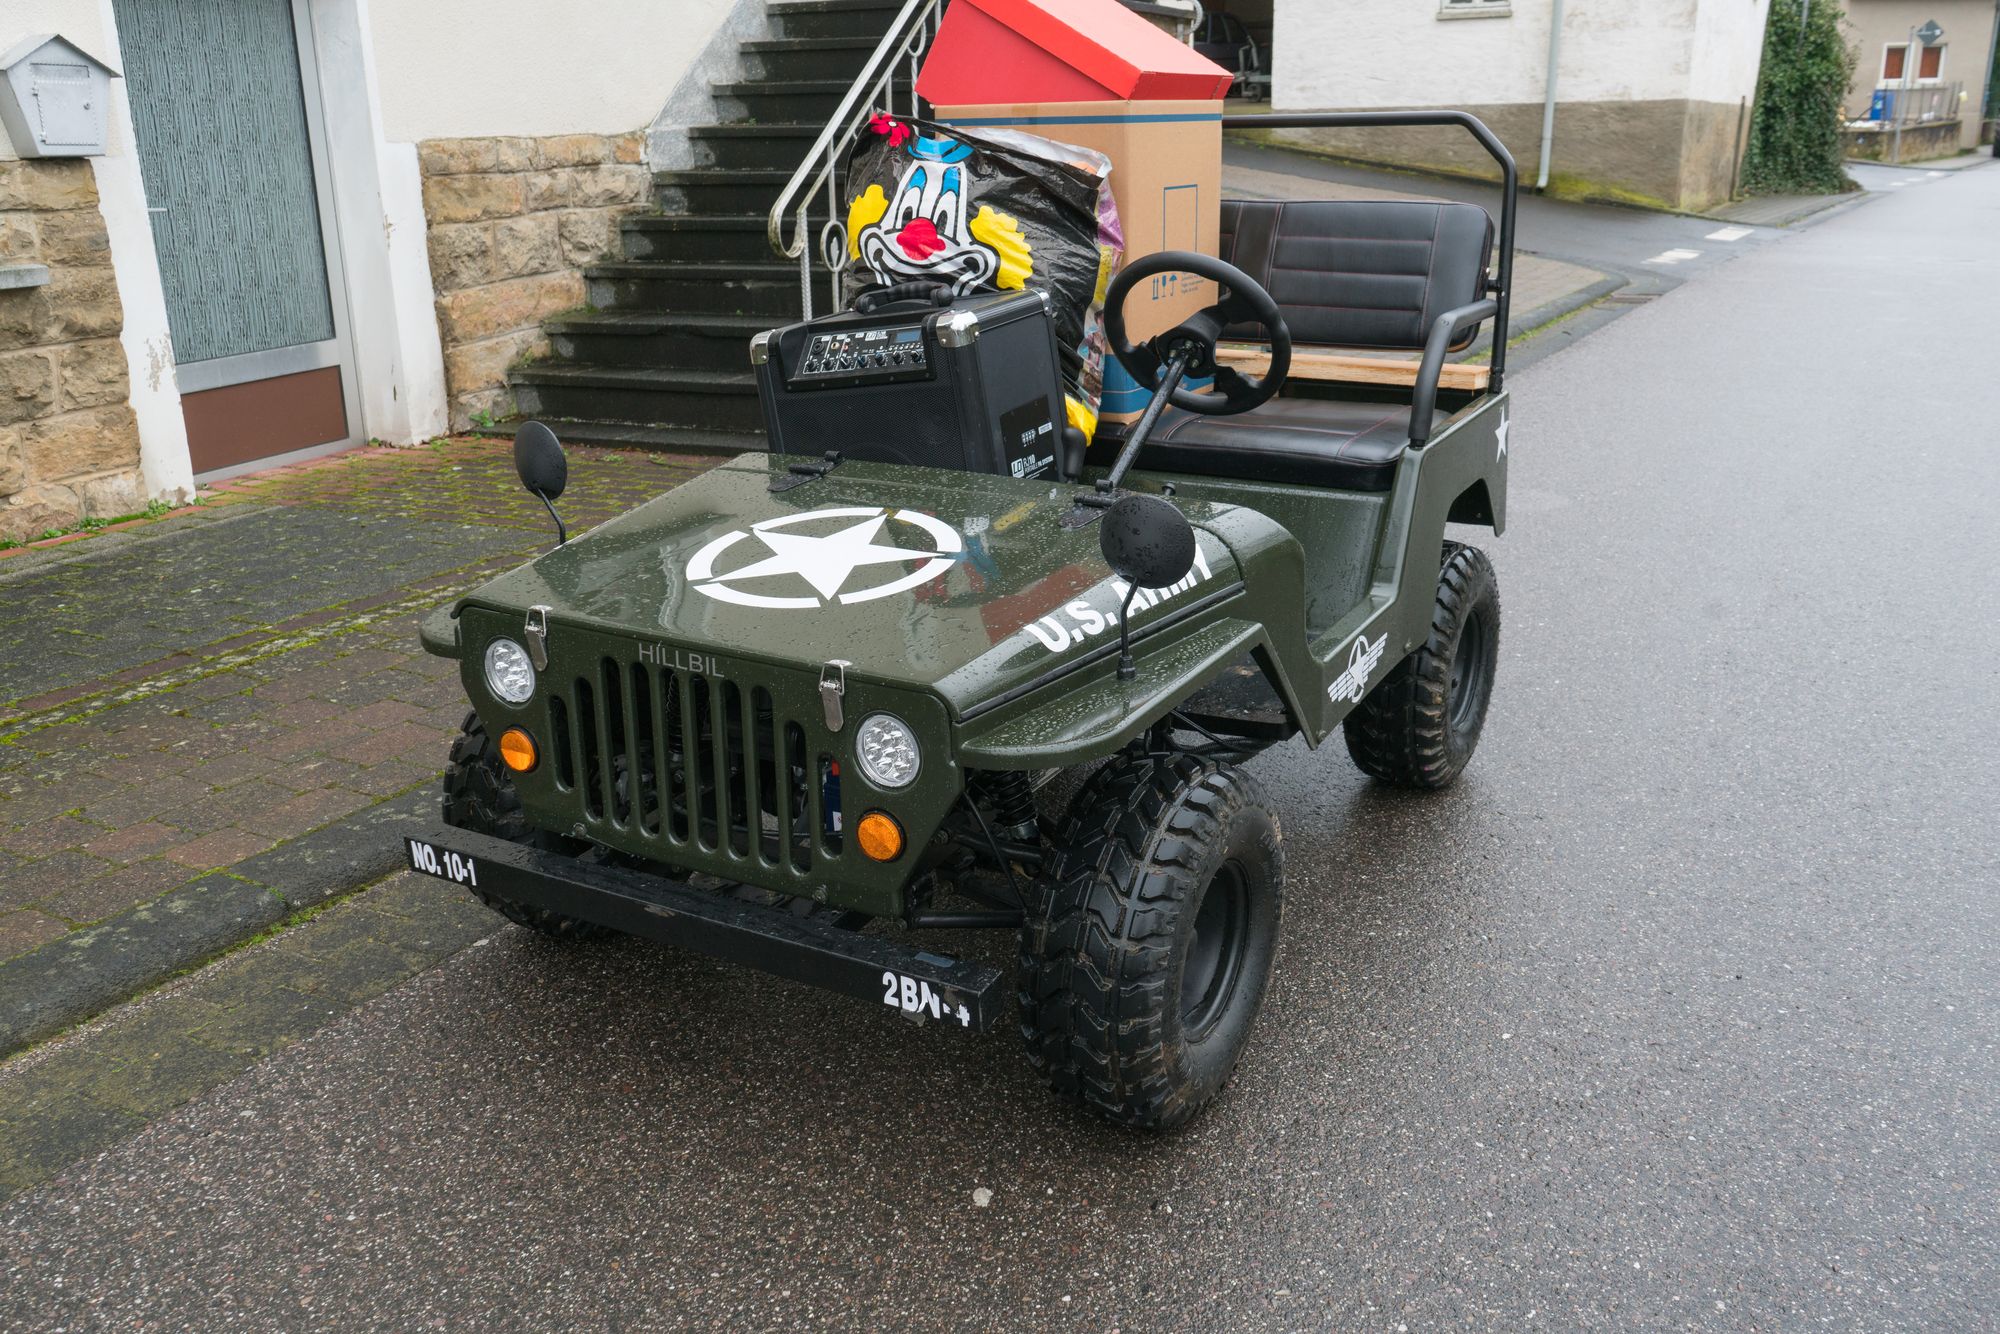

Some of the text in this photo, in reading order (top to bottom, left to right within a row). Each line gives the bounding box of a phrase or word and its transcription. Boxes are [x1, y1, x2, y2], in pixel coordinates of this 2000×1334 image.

[1023, 543, 1212, 652] U.S. AY
[638, 642, 725, 678] HILLBIL
[410, 840, 477, 886] NO. 10-1
